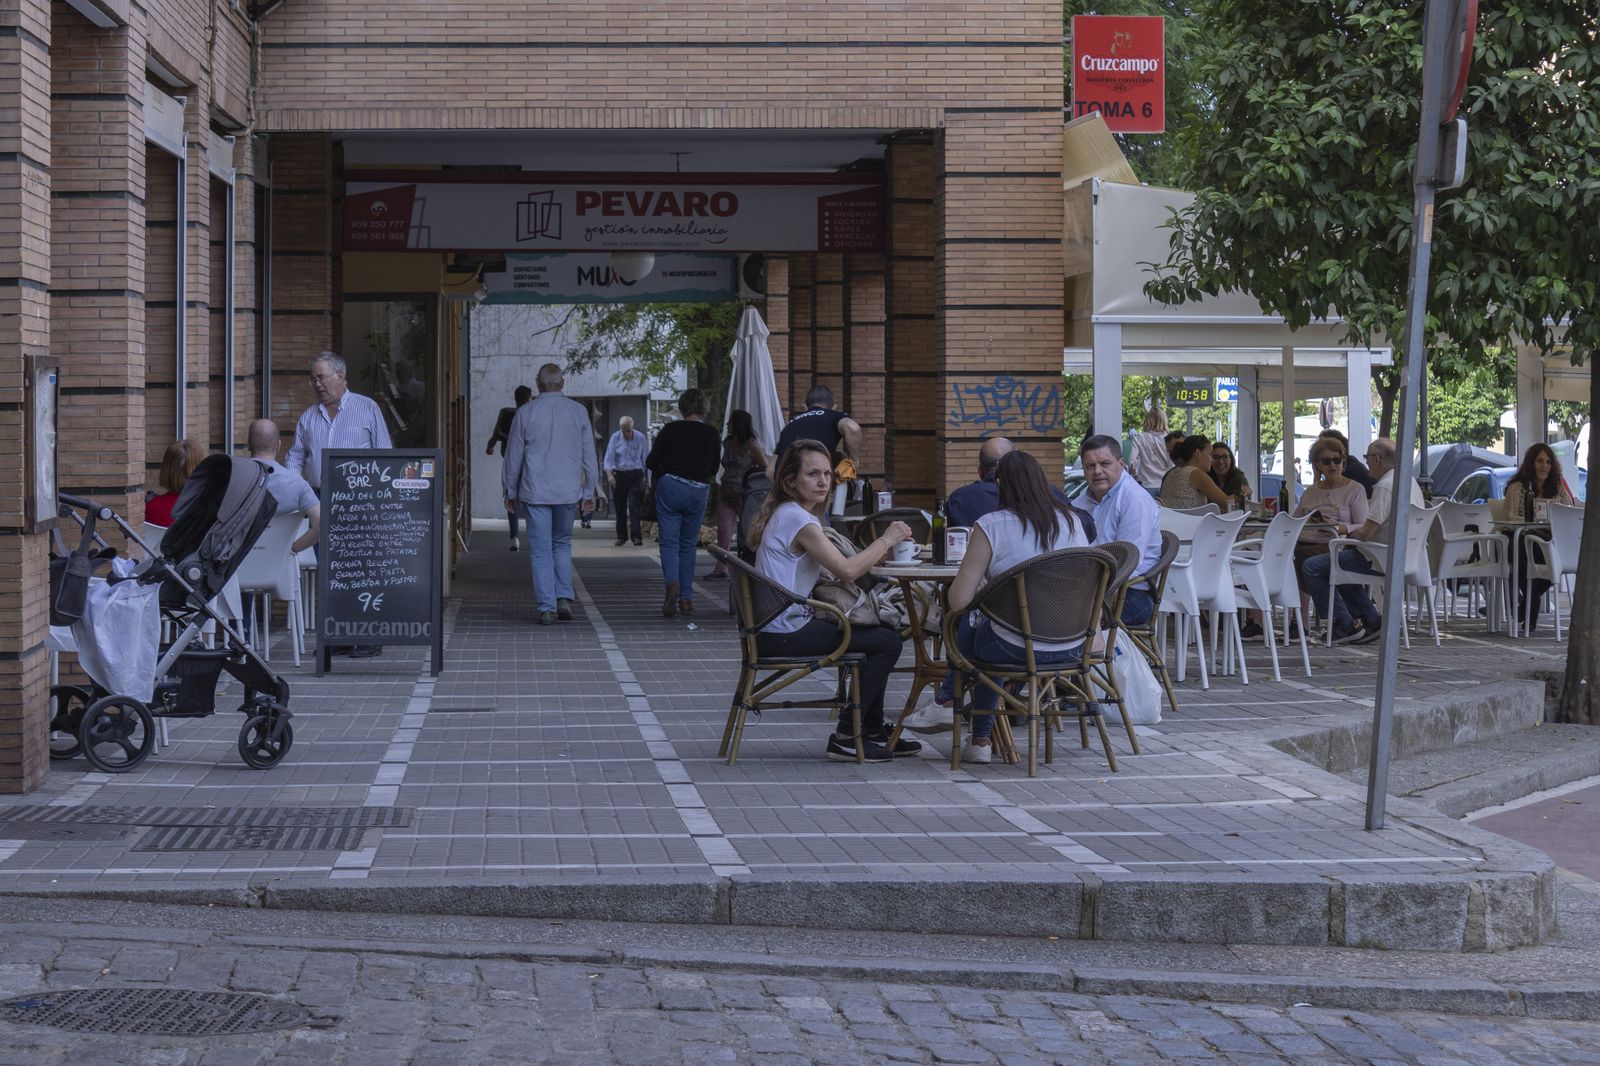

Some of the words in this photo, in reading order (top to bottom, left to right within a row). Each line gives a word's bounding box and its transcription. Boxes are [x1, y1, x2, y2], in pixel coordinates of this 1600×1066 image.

[1081, 54, 1158, 74] Cruzcampo
[1075, 101, 1135, 118] TOMA
[1142, 101, 1153, 118] 6
[576, 191, 738, 217] PEVARO
[388, 220, 405, 228] 777
[585, 224, 638, 241] gestión
[642, 220, 728, 236] inmobiliaria
[1176, 389, 1208, 401] 10:58
[336, 460, 380, 476] TOMA
[379, 466, 392, 483] 6
[344, 475, 372, 489] BAR
[395, 480, 428, 488] Cruzcampo
[331, 490, 356, 503] MENÚ
[358, 492, 374, 501] DEL
[376, 488, 393, 499] DÍA
[380, 503, 404, 511] ENTRE
[361, 513, 368, 521] A
[370, 513, 379, 521] LA
[386, 548, 421, 556] PATATAS
[366, 558, 400, 568] RELLENA
[368, 569, 377, 577] DE
[380, 567, 407, 577] PASTA
[350, 578, 381, 589] BEBIDA
[384, 577, 391, 587] Y
[391, 575, 418, 585] POSTRE
[357, 592, 386, 612] 9€
[323, 616, 433, 638] Cruzcampo
